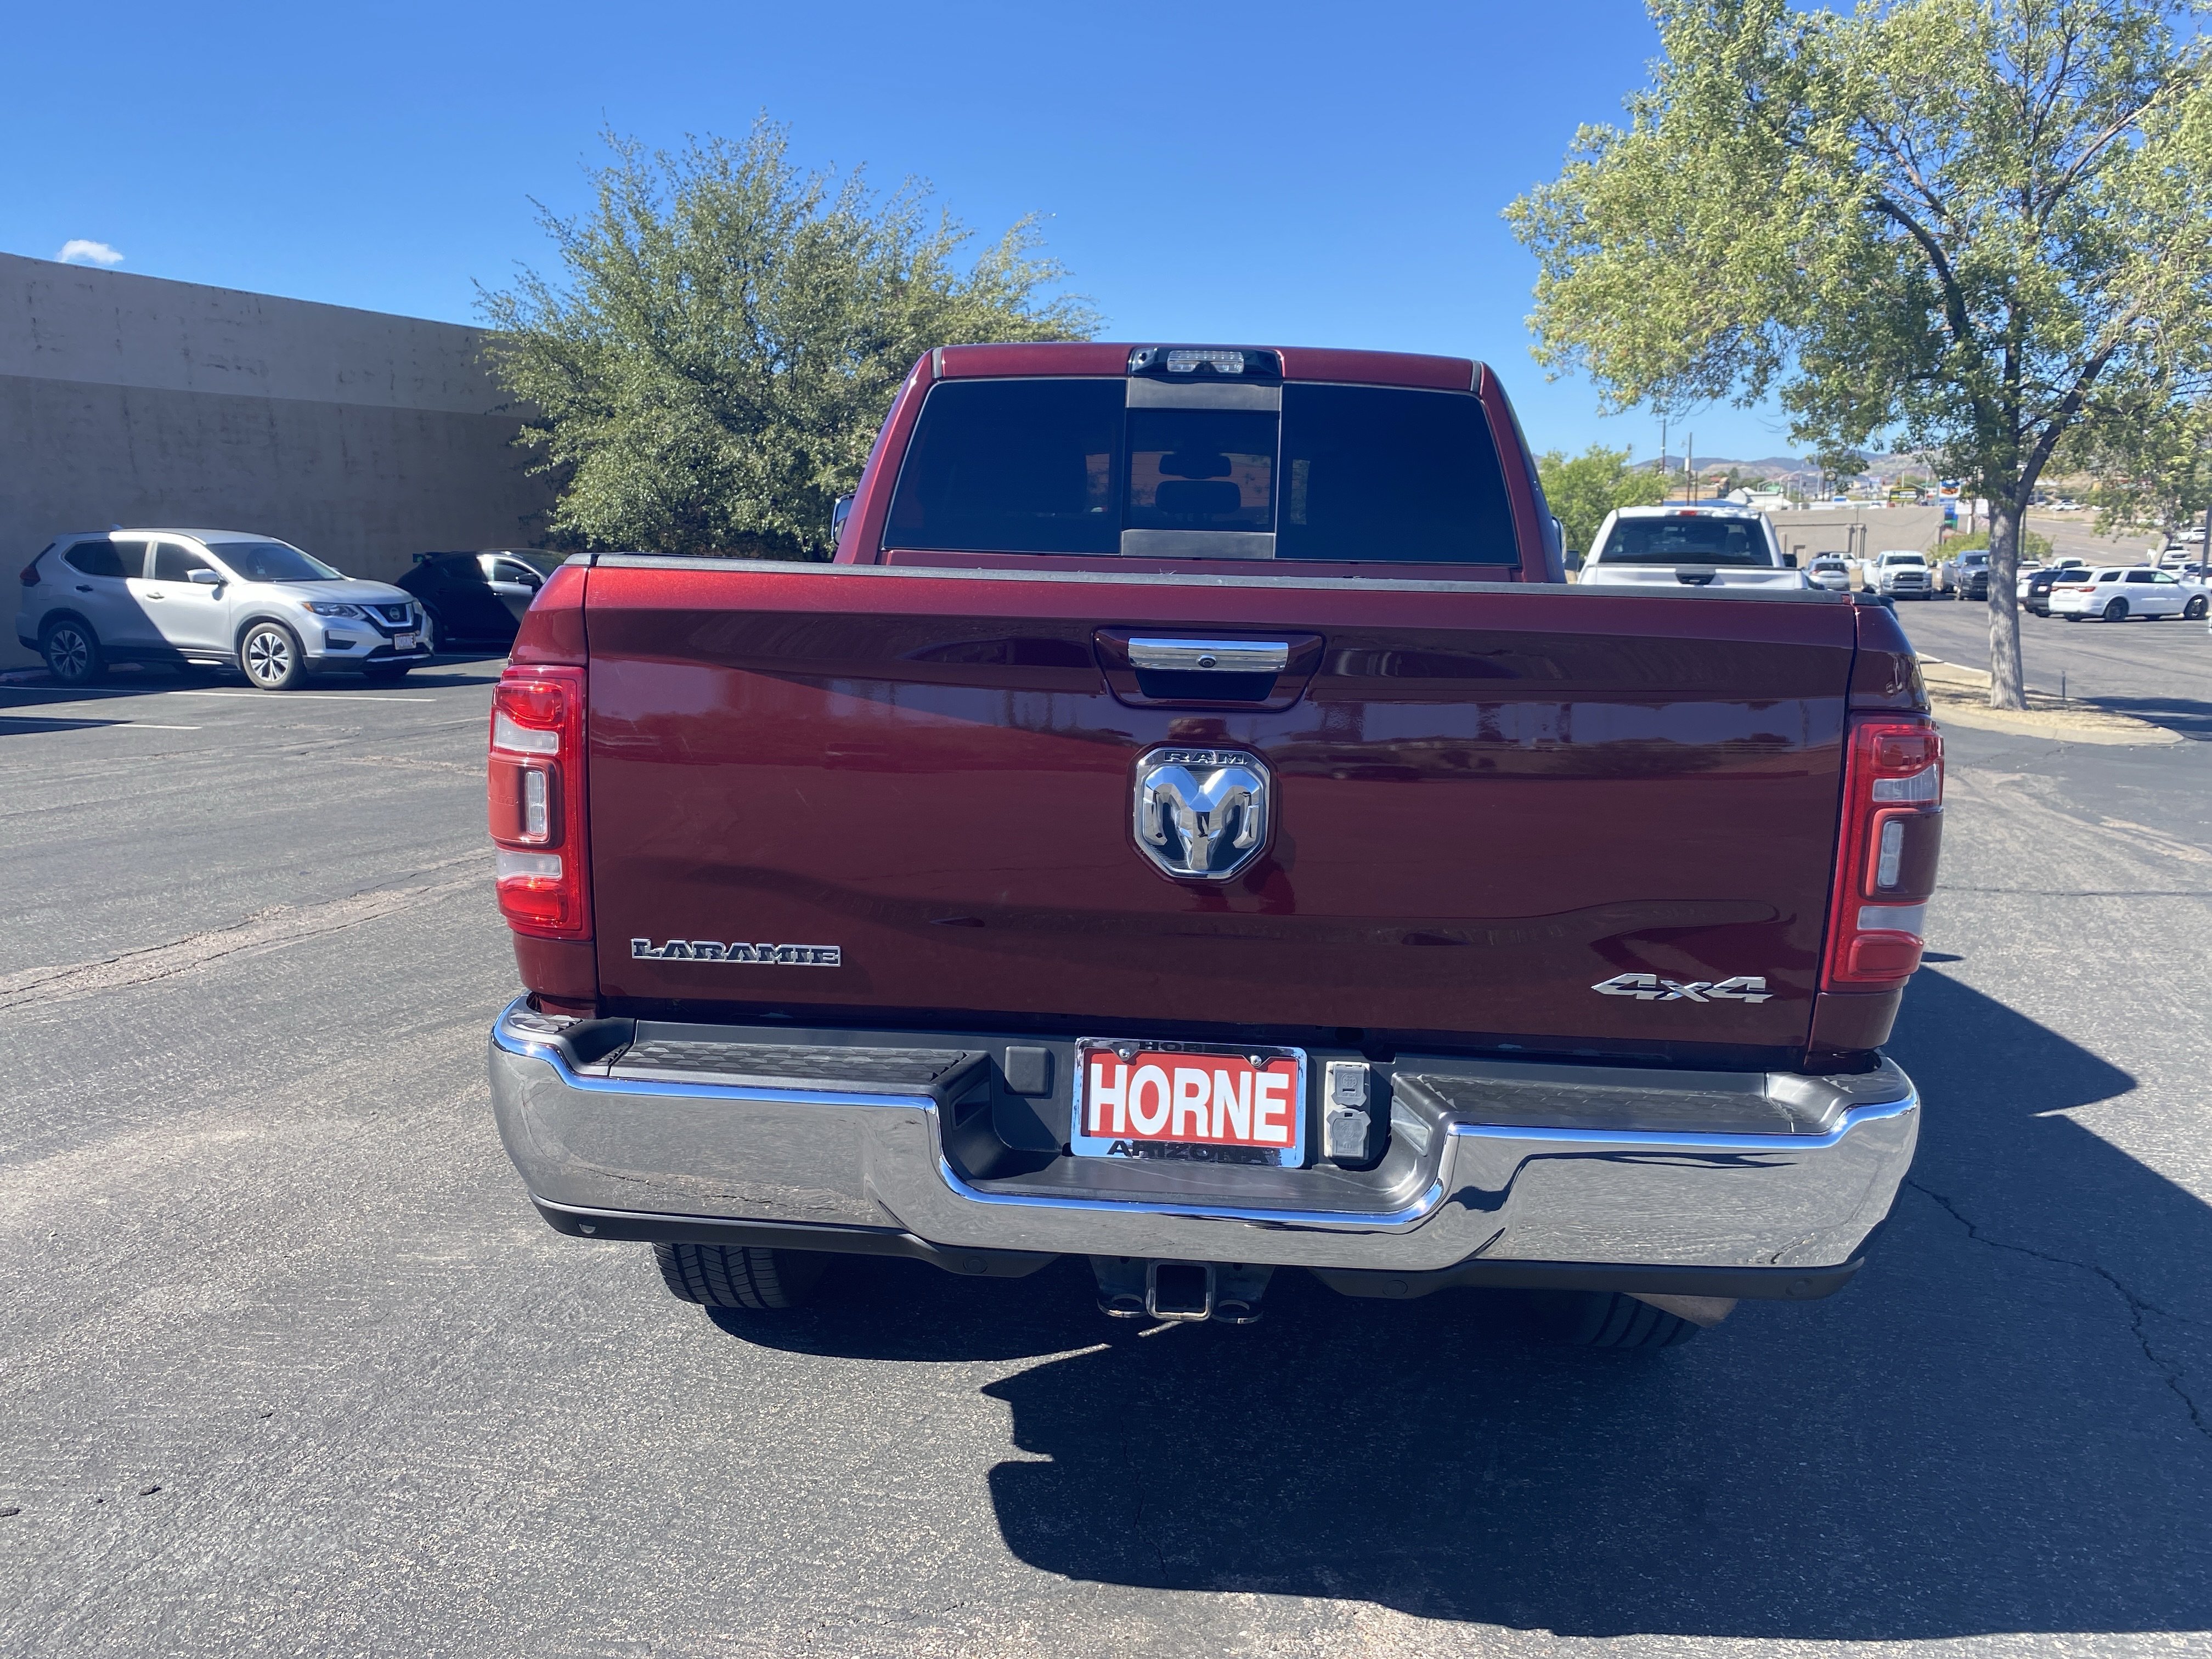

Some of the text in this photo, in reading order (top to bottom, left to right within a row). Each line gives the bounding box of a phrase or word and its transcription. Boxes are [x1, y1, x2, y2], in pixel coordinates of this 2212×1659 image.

[1164, 751, 1244, 765] RAM
[631, 938, 841, 967] LARAMIE
[1088, 1063, 1289, 1143] HORNE
